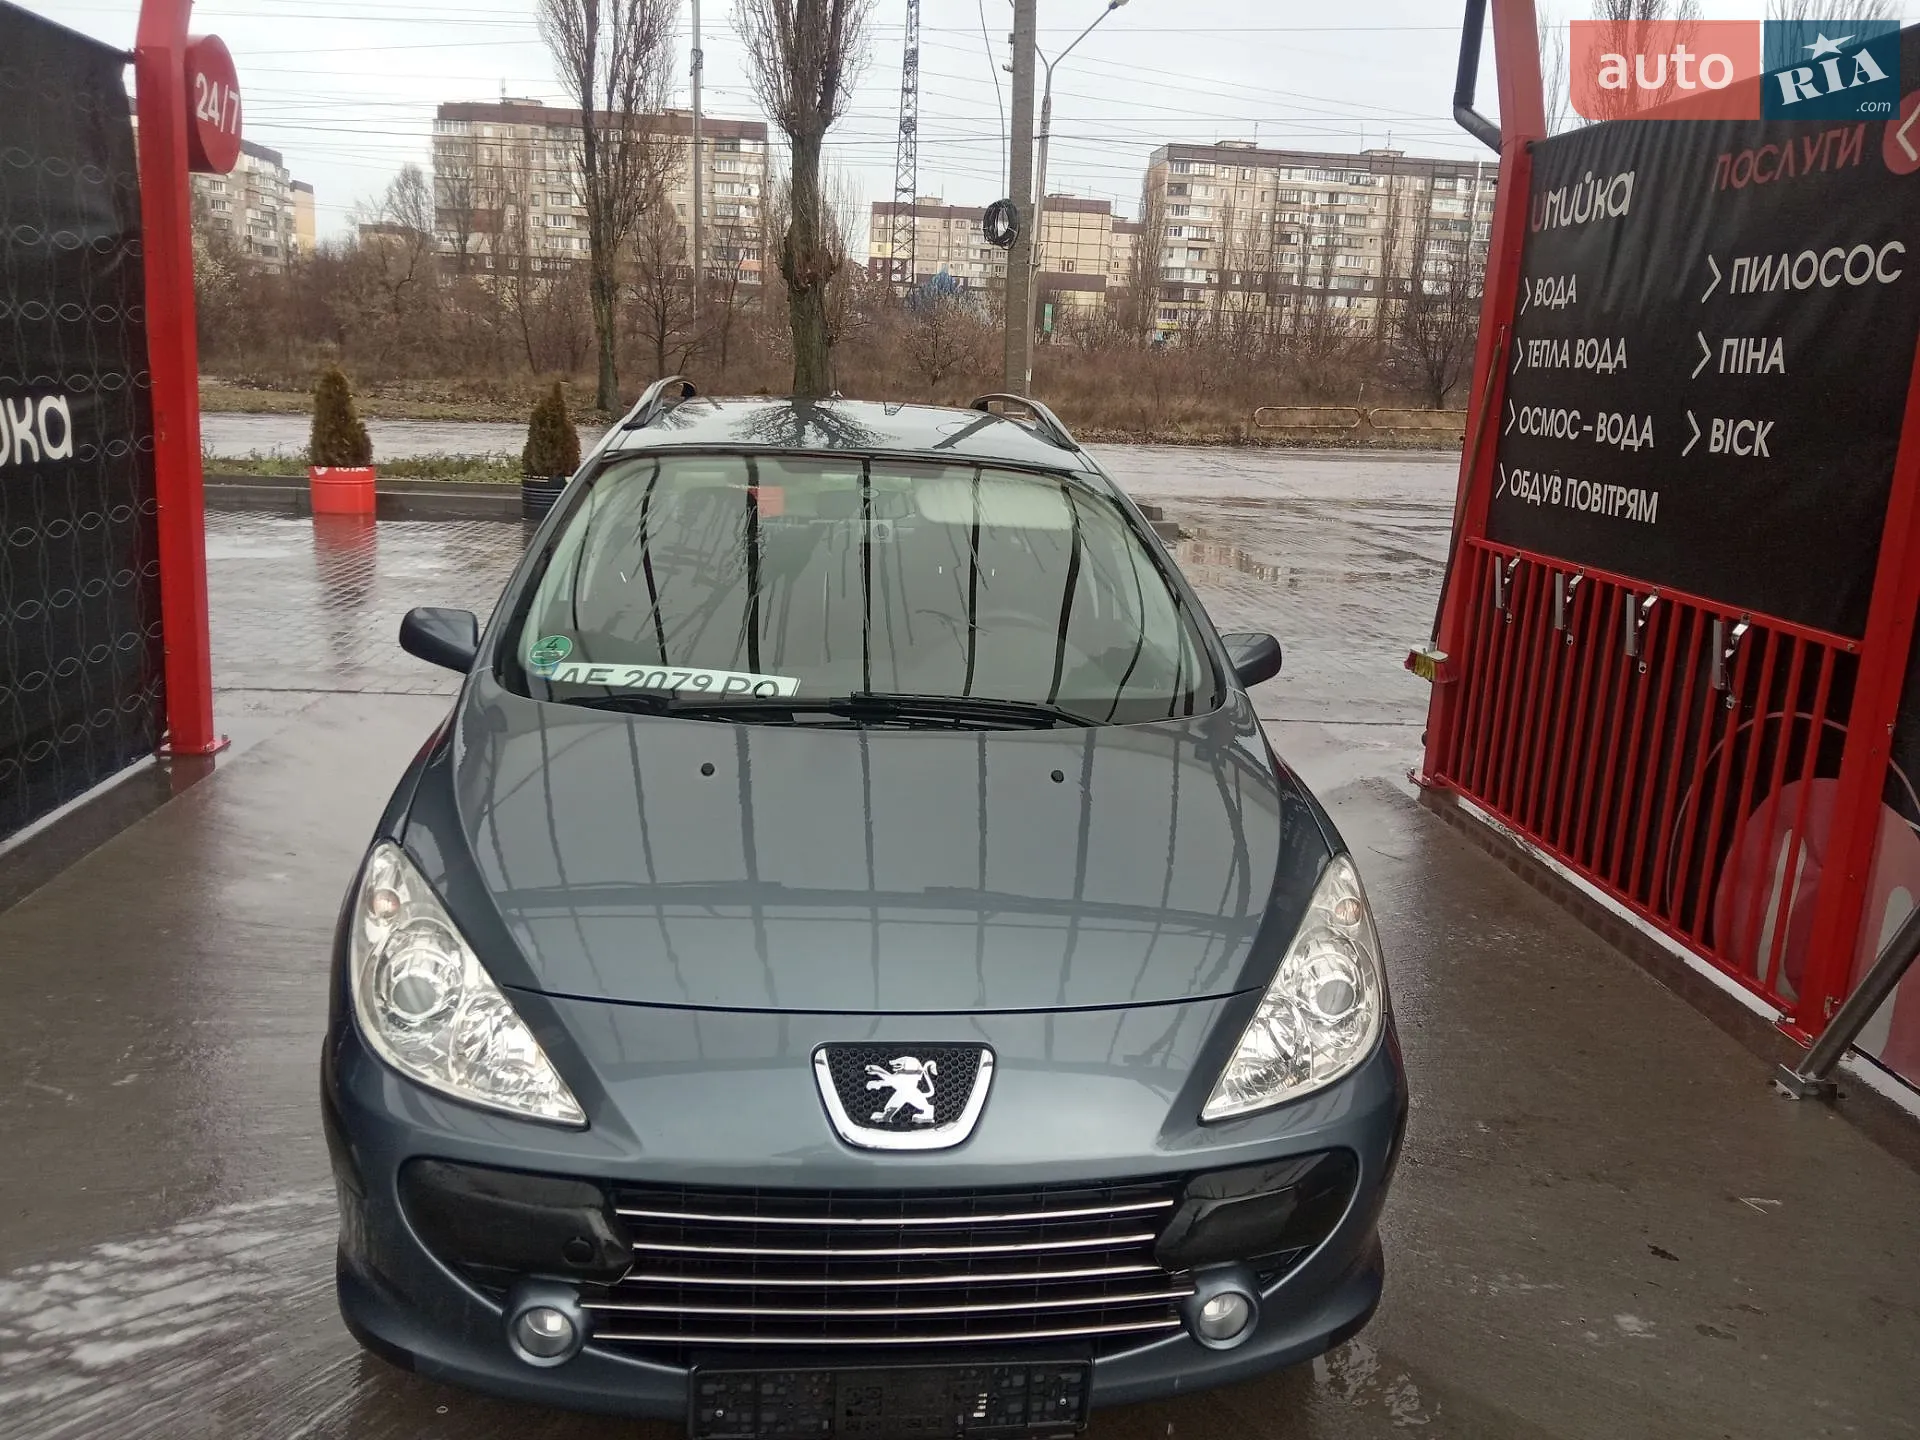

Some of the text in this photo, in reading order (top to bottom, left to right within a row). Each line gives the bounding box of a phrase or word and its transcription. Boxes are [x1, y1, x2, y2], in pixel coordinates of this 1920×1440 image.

[196, 72, 239, 134] 24/7
[1711, 124, 1866, 192] ПОСЛУГИ
[1730, 241, 1906, 294] ПИЛОСОС
[1533, 274, 1577, 310] ВОДА
[1527, 337, 1627, 374] ТЕПЛА ВОДА
[1719, 337, 1786, 374] ПІНА
[1709, 419, 1775, 458] ВІСК
[1510, 469, 1659, 524] ОБДУВ ПОВІТРЯМ
[624, 669, 713, 693] 2079
